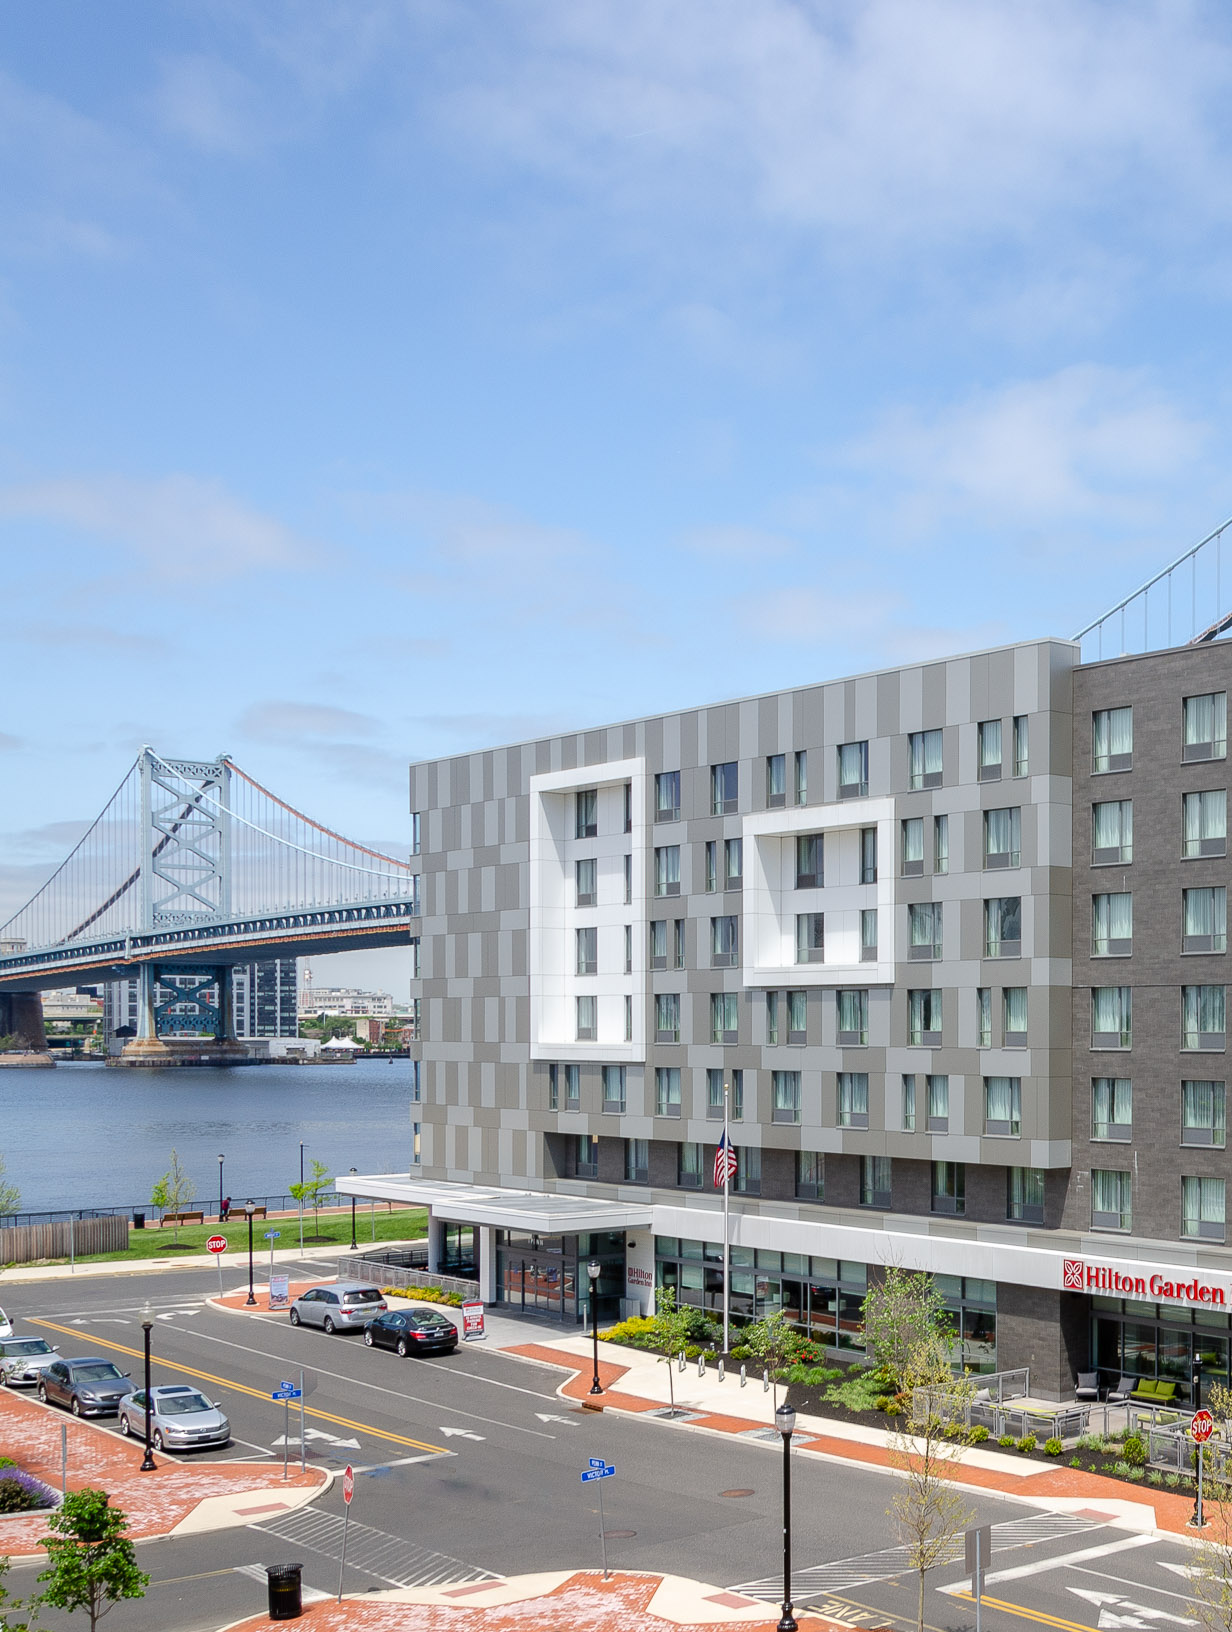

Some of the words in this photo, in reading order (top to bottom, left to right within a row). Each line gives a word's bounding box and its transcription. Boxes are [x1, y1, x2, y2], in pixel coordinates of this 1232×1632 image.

[208, 1240, 226, 1249] STOP
[633, 1267, 652, 1280] Hilton
[628, 1276, 644, 1285] Garden
[645, 1279, 653, 1287] Inn
[1086, 1265, 1146, 1294] Hilton
[1149, 1274, 1226, 1305] Garden
[1193, 1420, 1211, 1434] STOP
[343, 1474, 354, 1492] STOP
[807, 1600, 896, 1630] LANE
